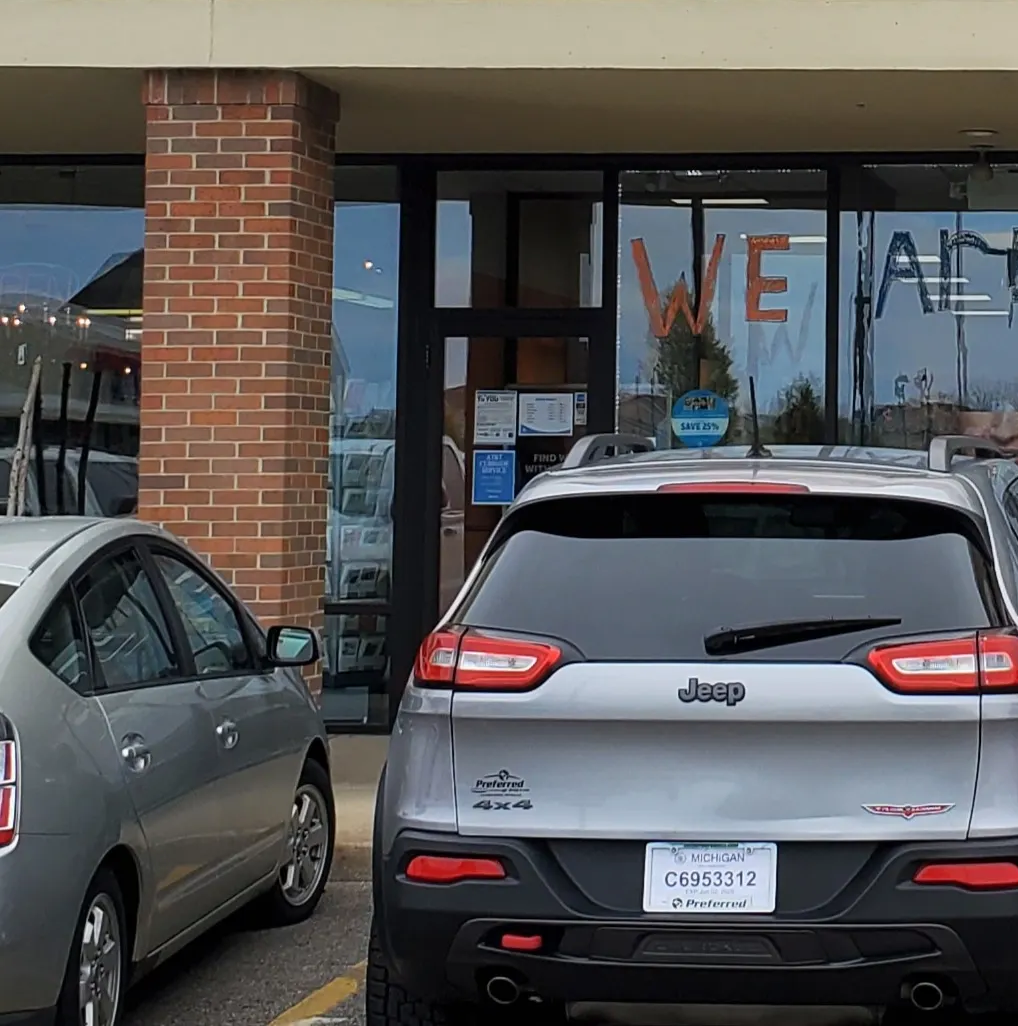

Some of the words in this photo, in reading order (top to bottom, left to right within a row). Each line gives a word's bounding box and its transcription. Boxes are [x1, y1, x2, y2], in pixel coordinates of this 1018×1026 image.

[630, 234, 790, 338] WE
[680, 422, 701, 431] SAVE
[702, 422, 720, 431] 25%
[533, 454, 557, 463] FIND
[678, 677, 746, 706] Jeep
[475, 779, 525, 789] Preferred
[472, 799, 534, 810] 4x4
[691, 853, 745, 863] MICHIGAN
[664, 870, 757, 887] C6953312
[685, 898, 748, 909] Preferred
